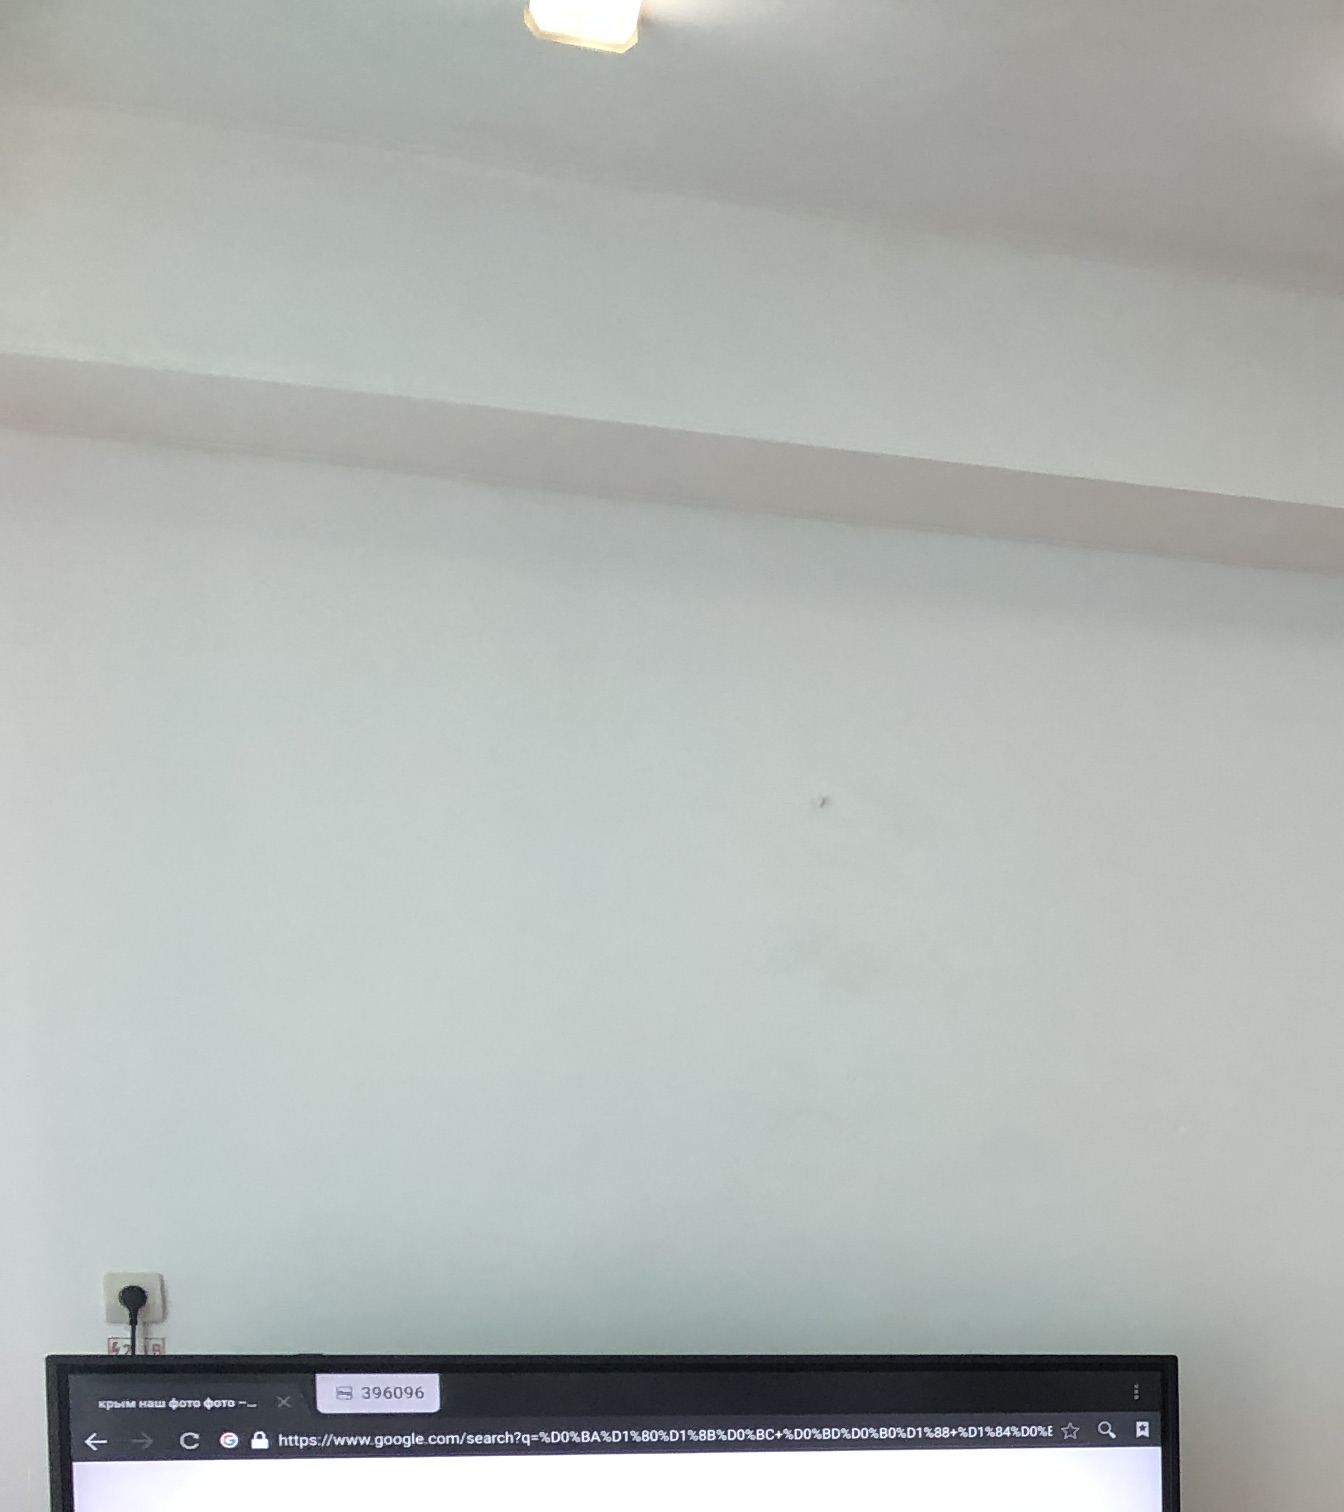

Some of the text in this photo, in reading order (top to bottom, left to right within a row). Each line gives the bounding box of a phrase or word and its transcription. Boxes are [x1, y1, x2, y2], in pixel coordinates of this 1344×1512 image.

[361, 1386, 425, 1400] 396096
[98, 1399, 137, 1411] крым
[138, 1399, 166, 1410] наш
[168, 1397, 201, 1411] фото
[202, 1397, 236, 1411] фото
